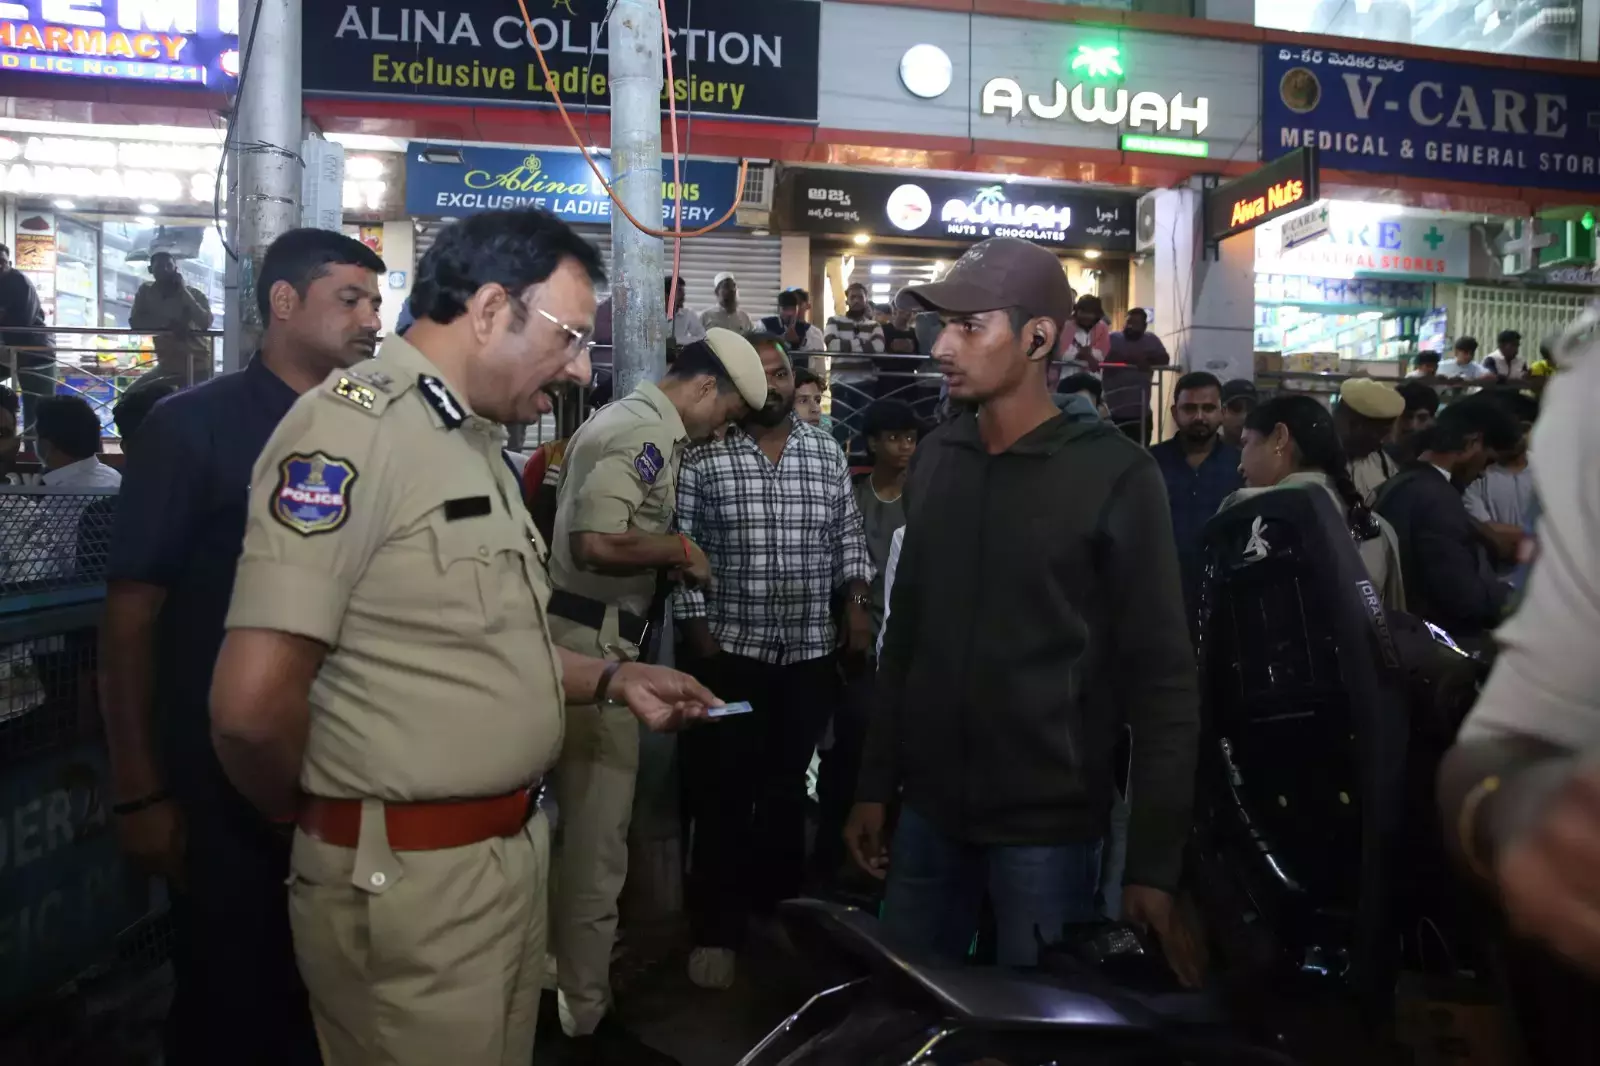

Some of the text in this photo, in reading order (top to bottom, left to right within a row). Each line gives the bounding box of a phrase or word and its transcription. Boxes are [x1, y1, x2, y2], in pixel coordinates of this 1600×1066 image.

[335, 5, 481, 47] ALINA
[30, 56, 73, 72] LIC
[83, 60, 118, 76] No
[127, 64, 145, 77] U
[154, 65, 198, 80] 221
[372, 53, 515, 90] Exclusive
[527, 63, 606, 96] Ladie
[982, 77, 1209, 135] AJWAH
[1342, 73, 1569, 138] V-CARE
[1281, 127, 1600, 176] MEDICAL & GENERAL STOR
[464, 166, 588, 196] Alina
[1268, 180, 1303, 211] Nuts
[436, 192, 546, 210] EXCLUSIVE
[553, 201, 612, 216] LADIE
[948, 224, 1065, 241] NUTS & CHOCOLATES
[1381, 255, 1446, 273] STORES
[281, 487, 344, 506] POLICE
